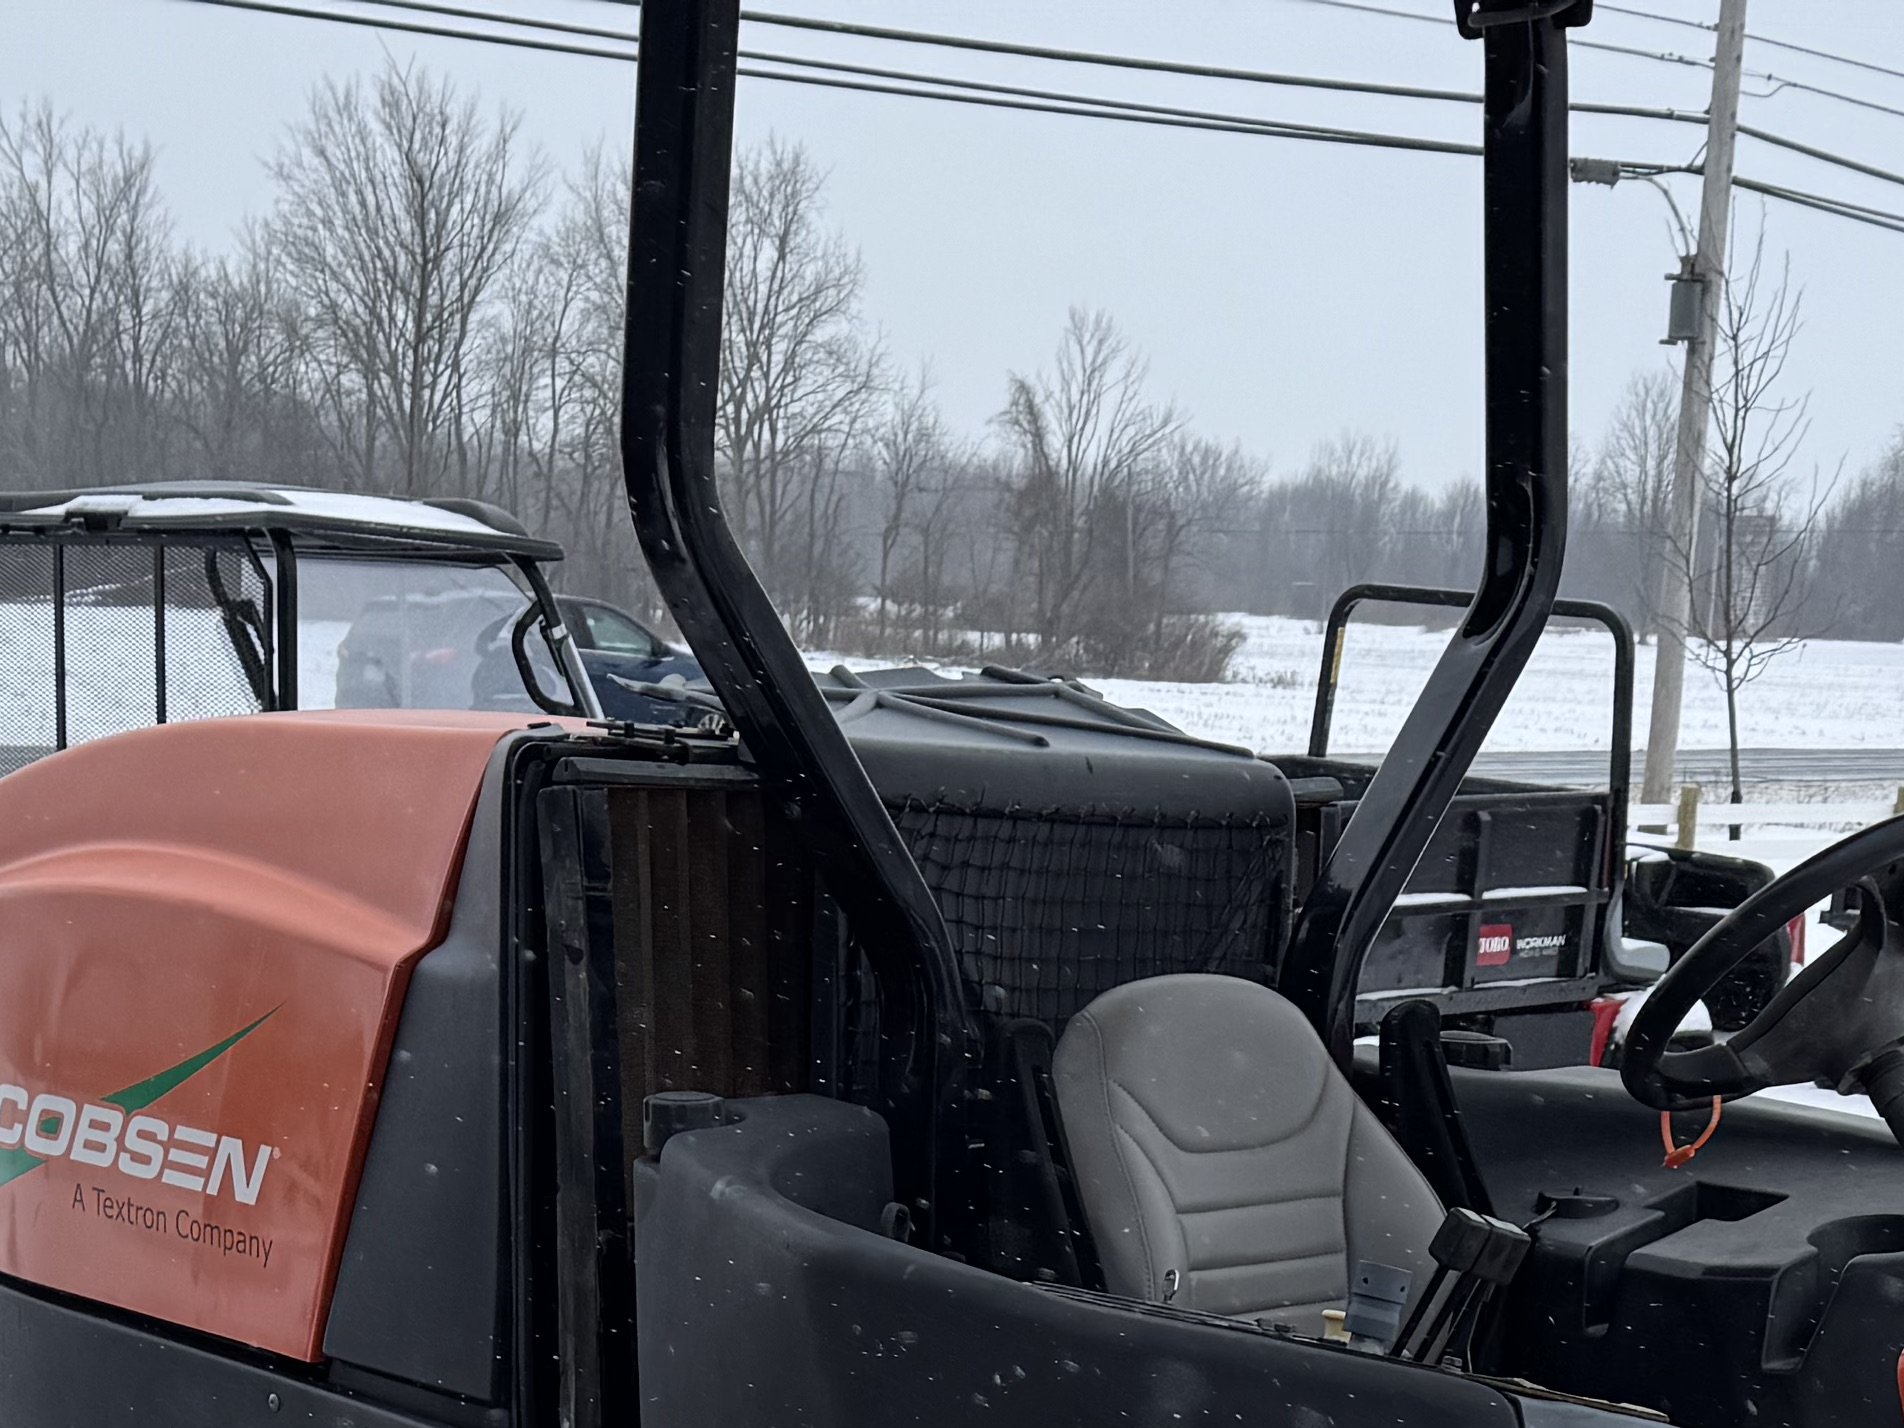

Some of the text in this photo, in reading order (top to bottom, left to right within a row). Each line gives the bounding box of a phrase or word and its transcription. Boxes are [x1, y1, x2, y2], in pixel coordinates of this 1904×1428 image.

[1478, 936, 1510, 954] TORO
[1515, 934, 1567, 950] WORKMAN
[72, 1183, 274, 1267] A Textron Company
